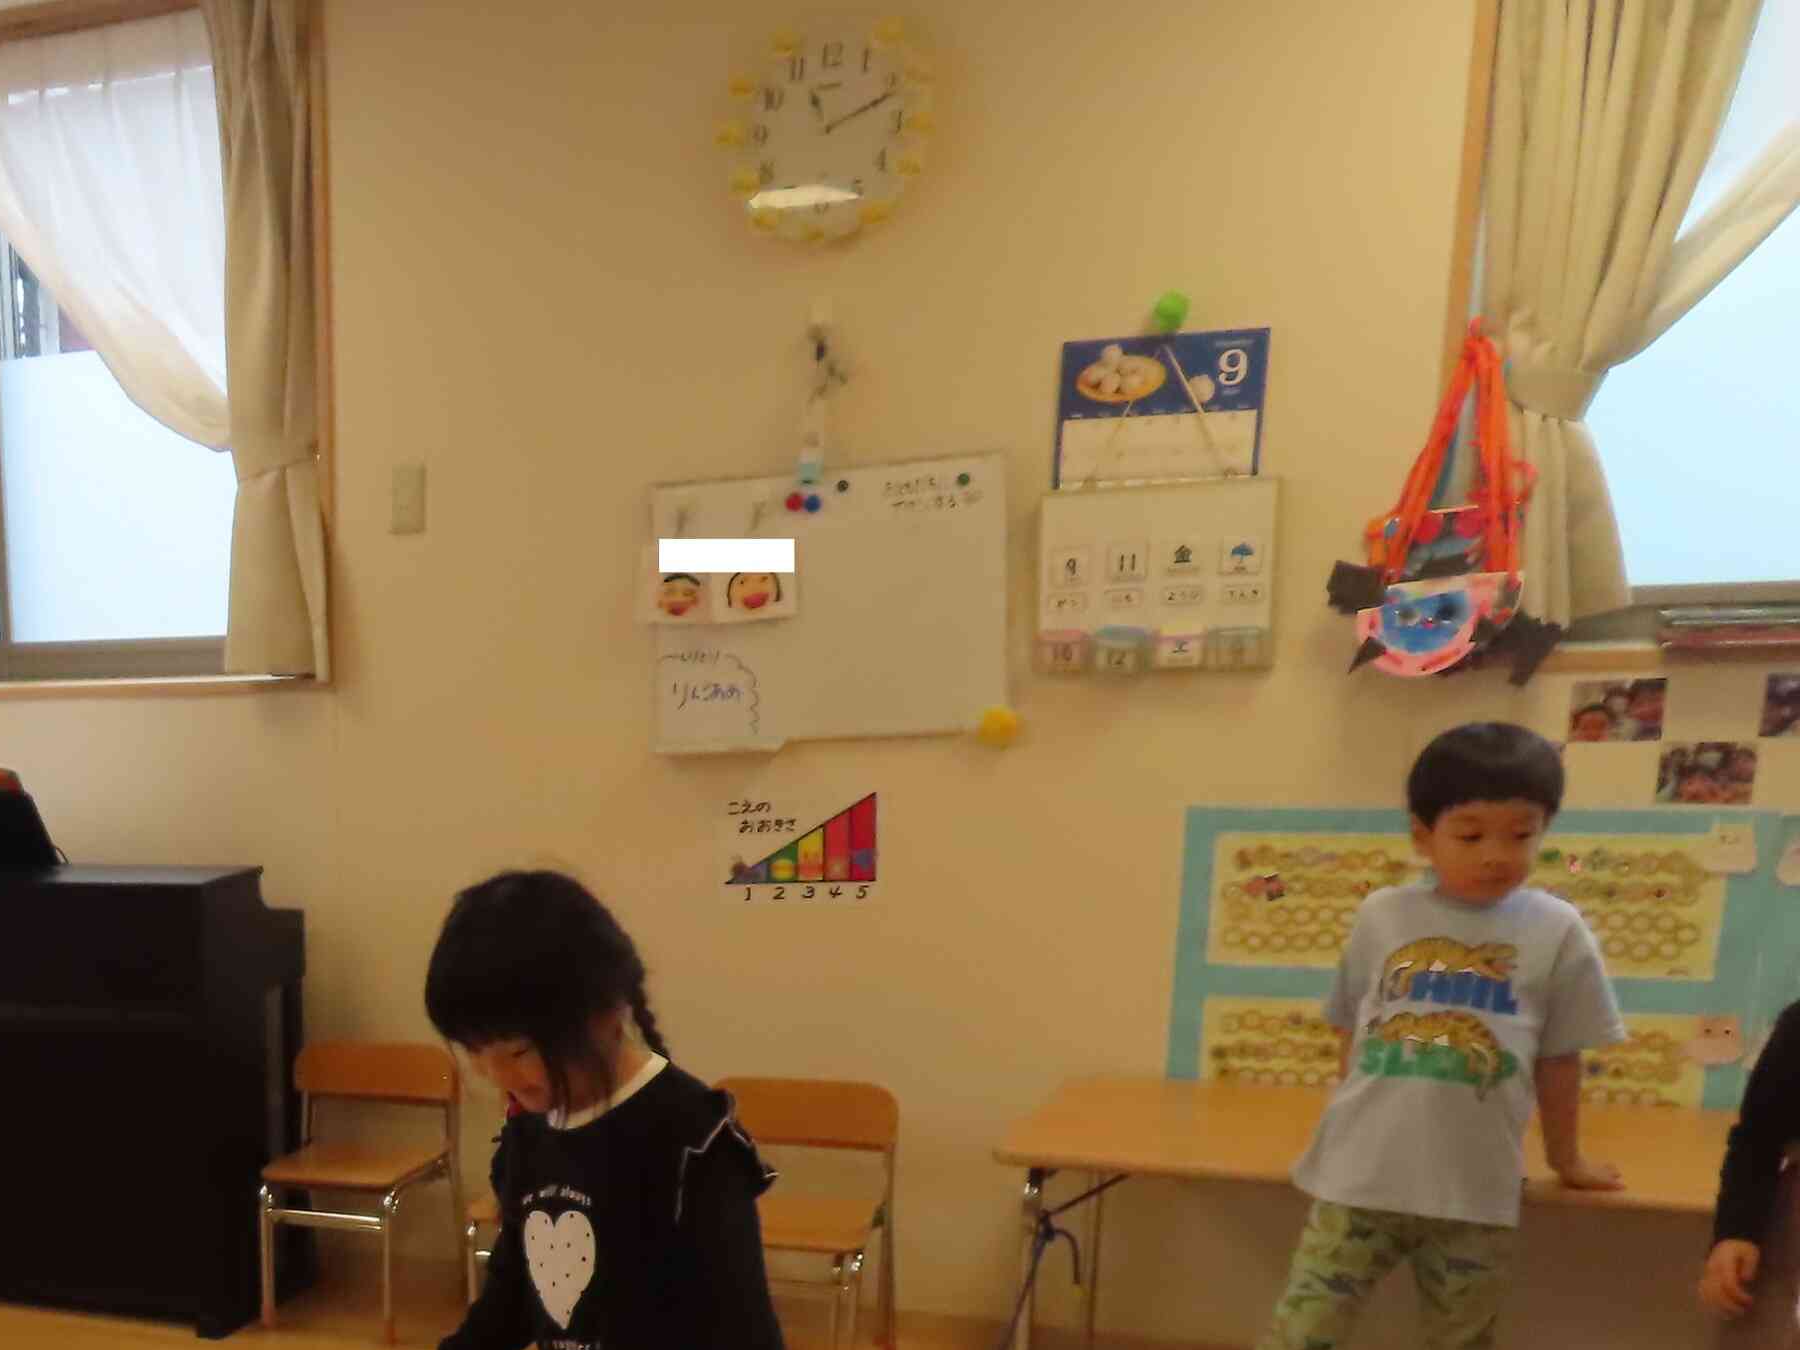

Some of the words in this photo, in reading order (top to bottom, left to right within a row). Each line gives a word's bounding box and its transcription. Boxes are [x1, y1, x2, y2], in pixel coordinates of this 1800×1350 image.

[821, 42, 844, 68] 12
[862, 46, 871, 74] 1
[789, 54, 805, 80] 11
[762, 84, 785, 112] 10
[1217, 348, 1249, 387] 9
[1064, 556, 1078, 577] 9
[1118, 552, 1138, 573] 11
[727, 799, 771, 816] こえの
[738, 818, 798, 834] おおきさ
[743, 886, 752, 901] 1
[772, 886, 786, 901] 2
[801, 885, 816, 900] 3
[828, 885, 844, 899] 4
[855, 885, 870, 900] 5
